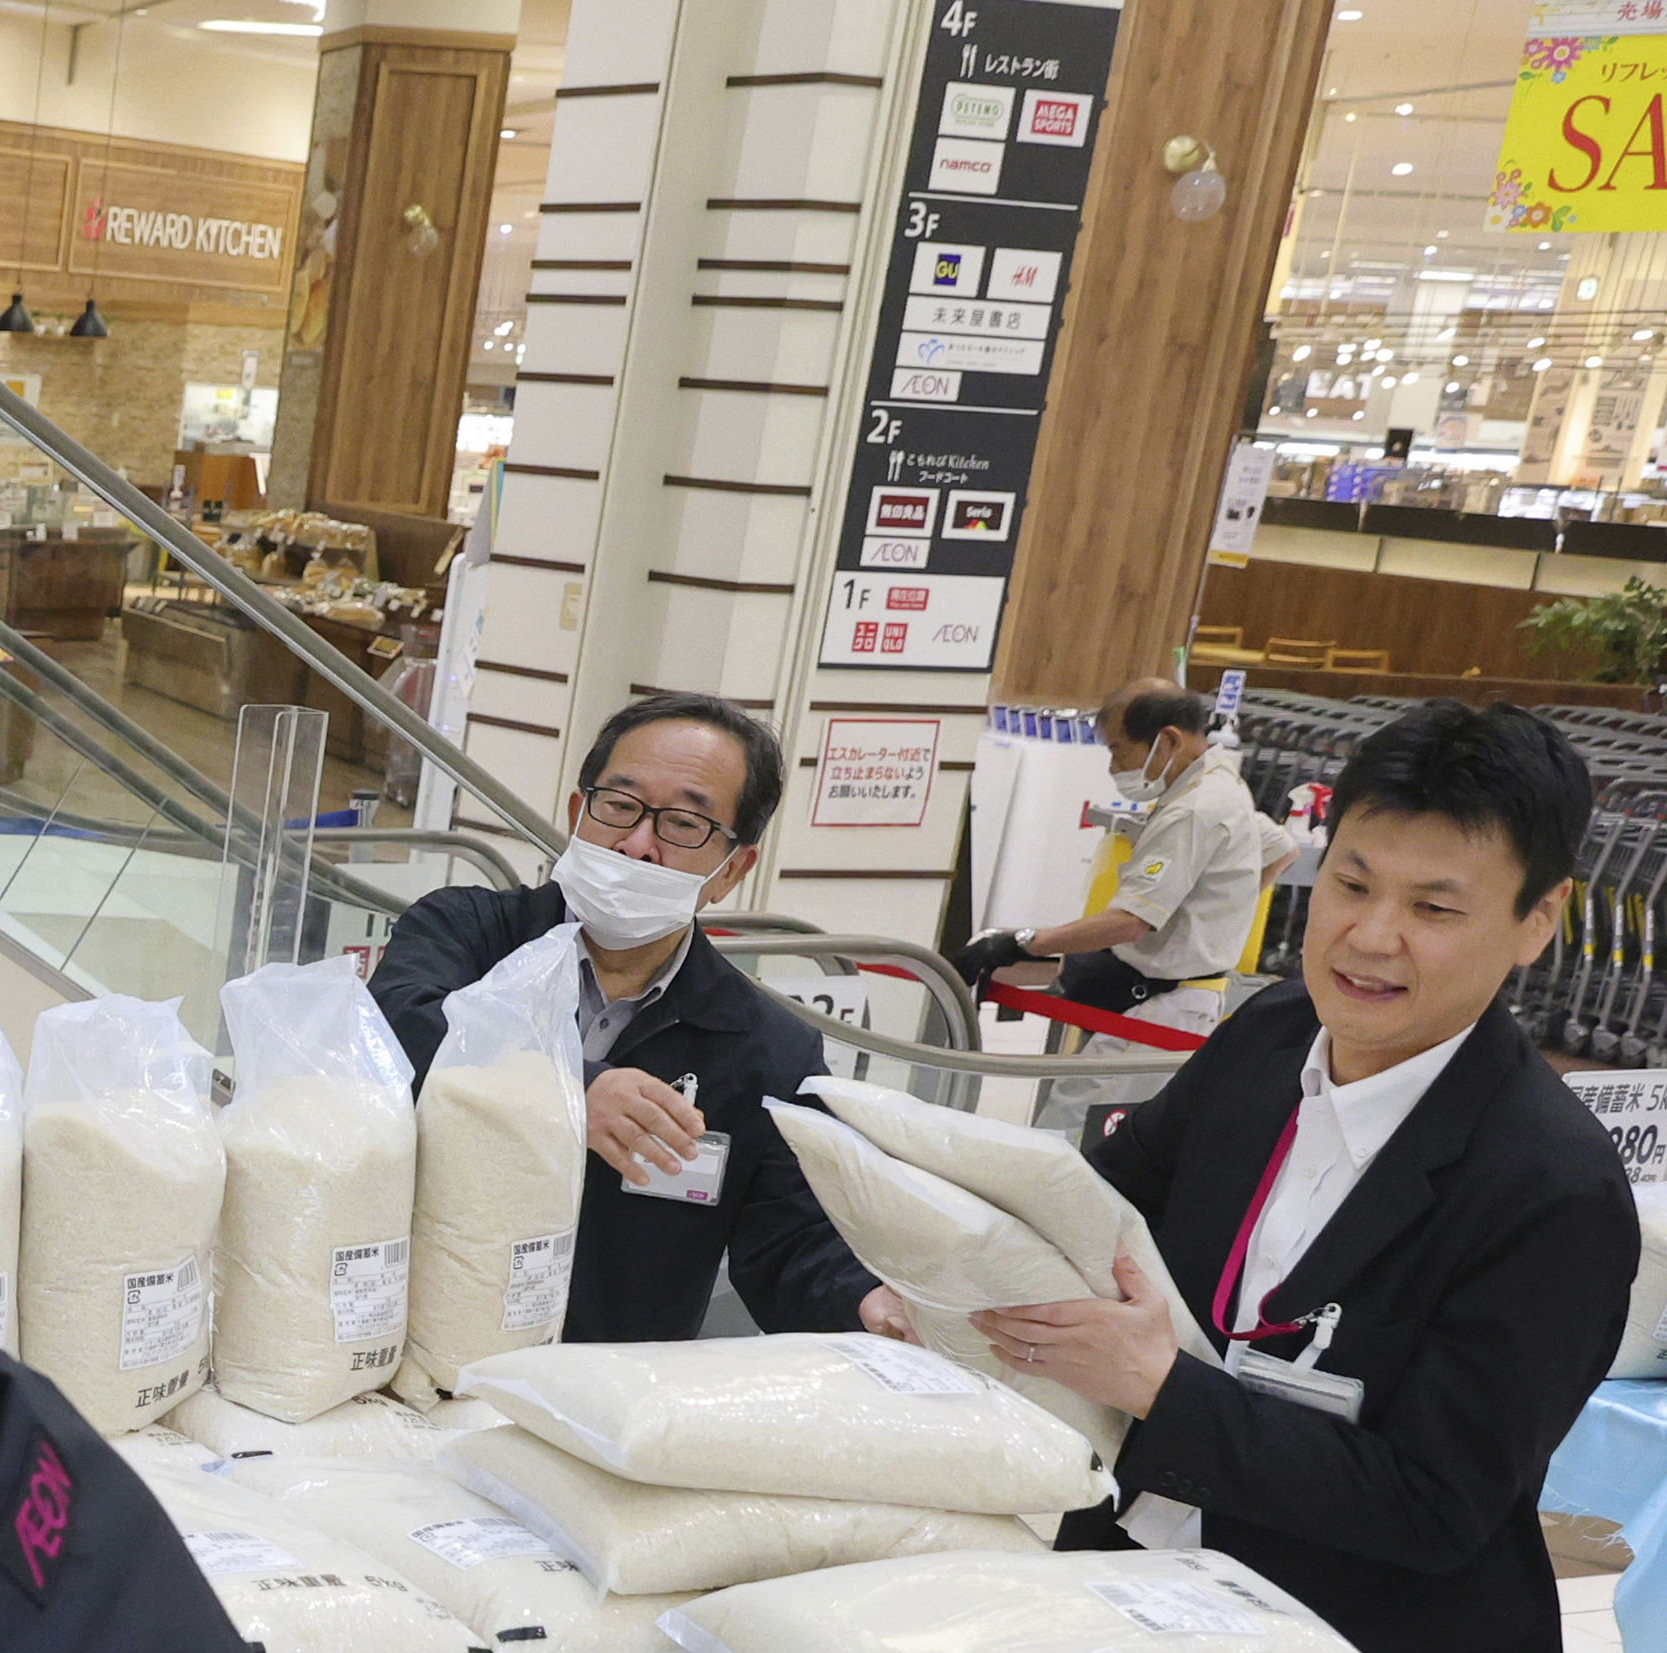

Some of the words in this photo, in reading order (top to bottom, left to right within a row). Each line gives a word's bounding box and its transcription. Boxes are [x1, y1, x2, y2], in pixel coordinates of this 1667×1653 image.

[940, 0, 978, 37] 4F
[1618, 0, 1667, 21] 売場
[985, 54, 1061, 80] レストラン街
[940, 158, 992, 173] namco
[106, 206, 192, 251] REWARD
[195, 216, 282, 261] KITCHEN
[904, 201, 940, 239] 3F
[934, 260, 960, 281] GU
[867, 408, 903, 445] 2F
[843, 578, 872, 610] 1F
